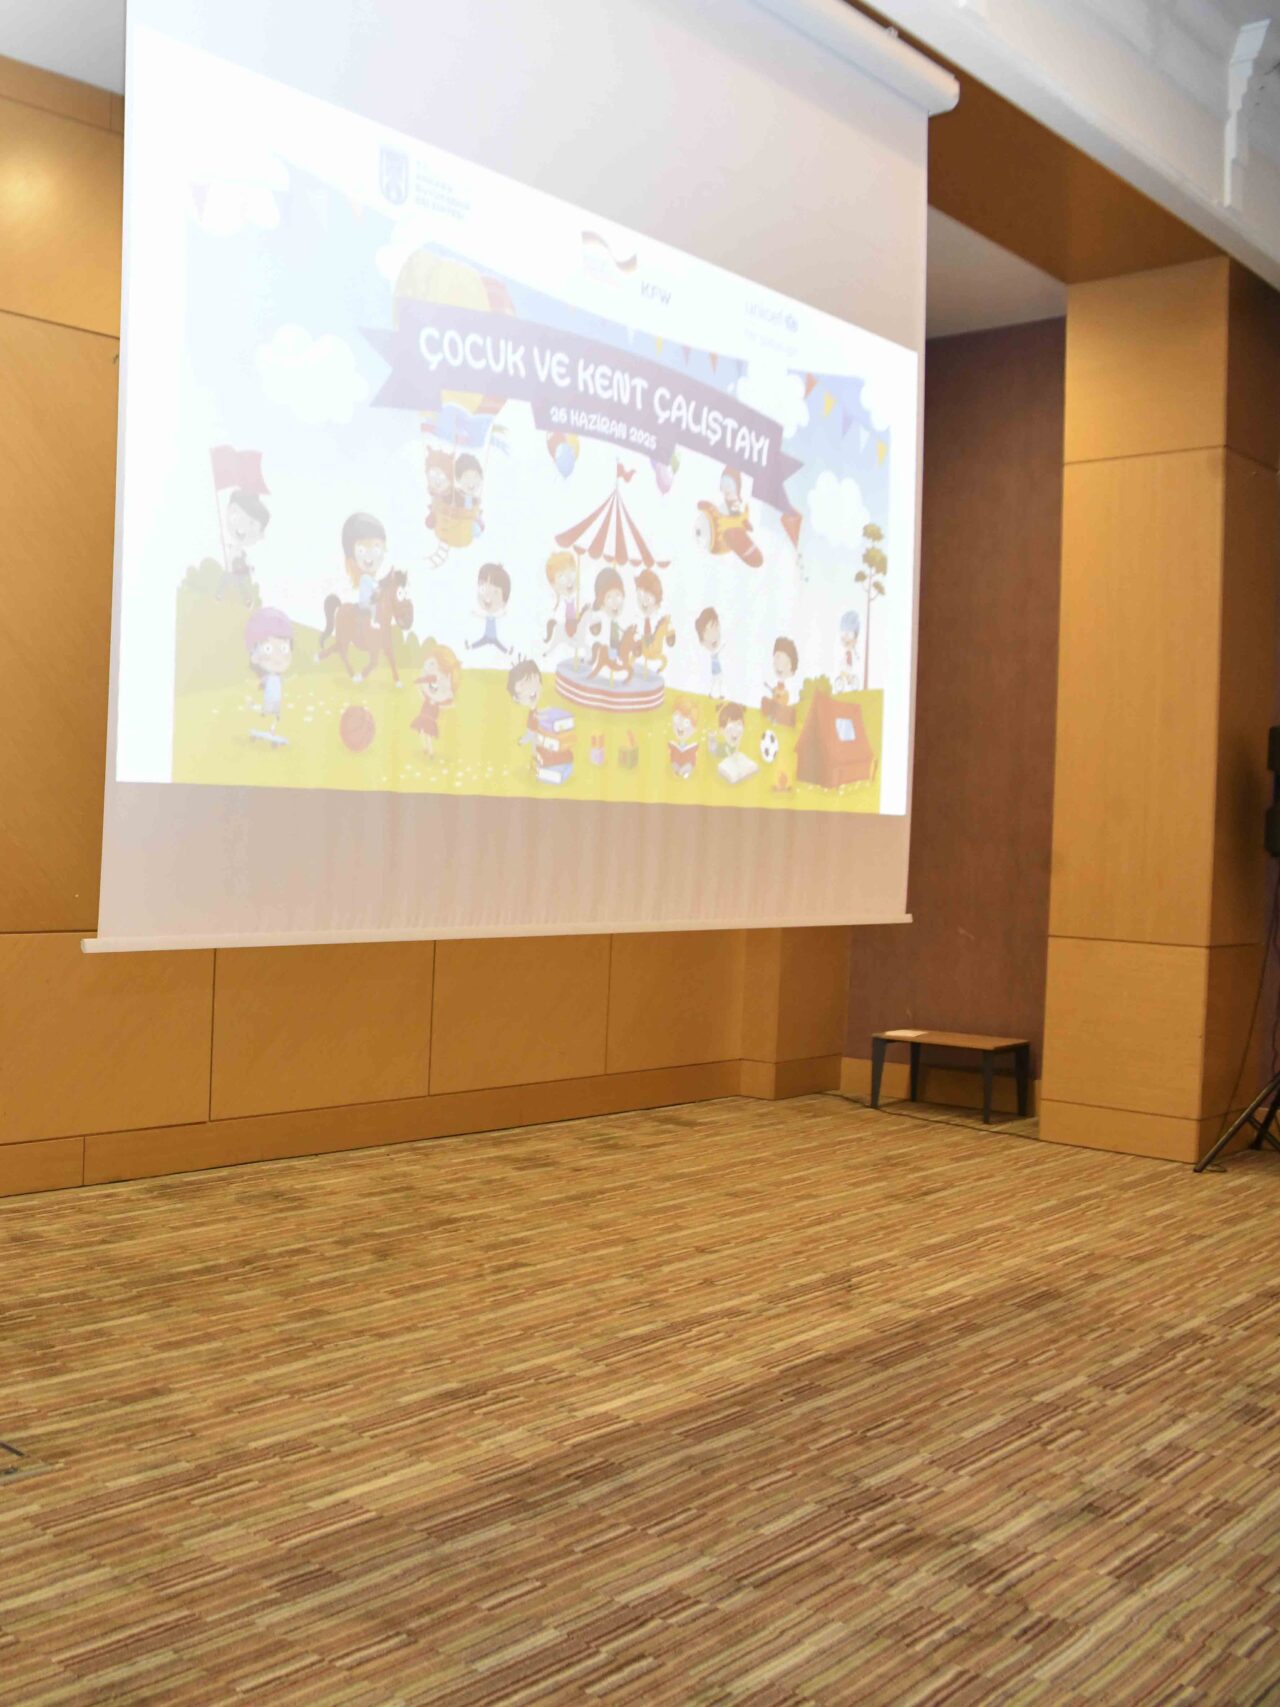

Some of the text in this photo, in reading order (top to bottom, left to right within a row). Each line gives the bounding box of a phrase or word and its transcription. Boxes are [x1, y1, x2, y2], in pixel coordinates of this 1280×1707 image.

[419, 326, 770, 467] ÇOCUK VE KENT ÇALIŞTAYI
[570, 408, 628, 440] HAZİRAN
[629, 426, 657, 450] 2025
